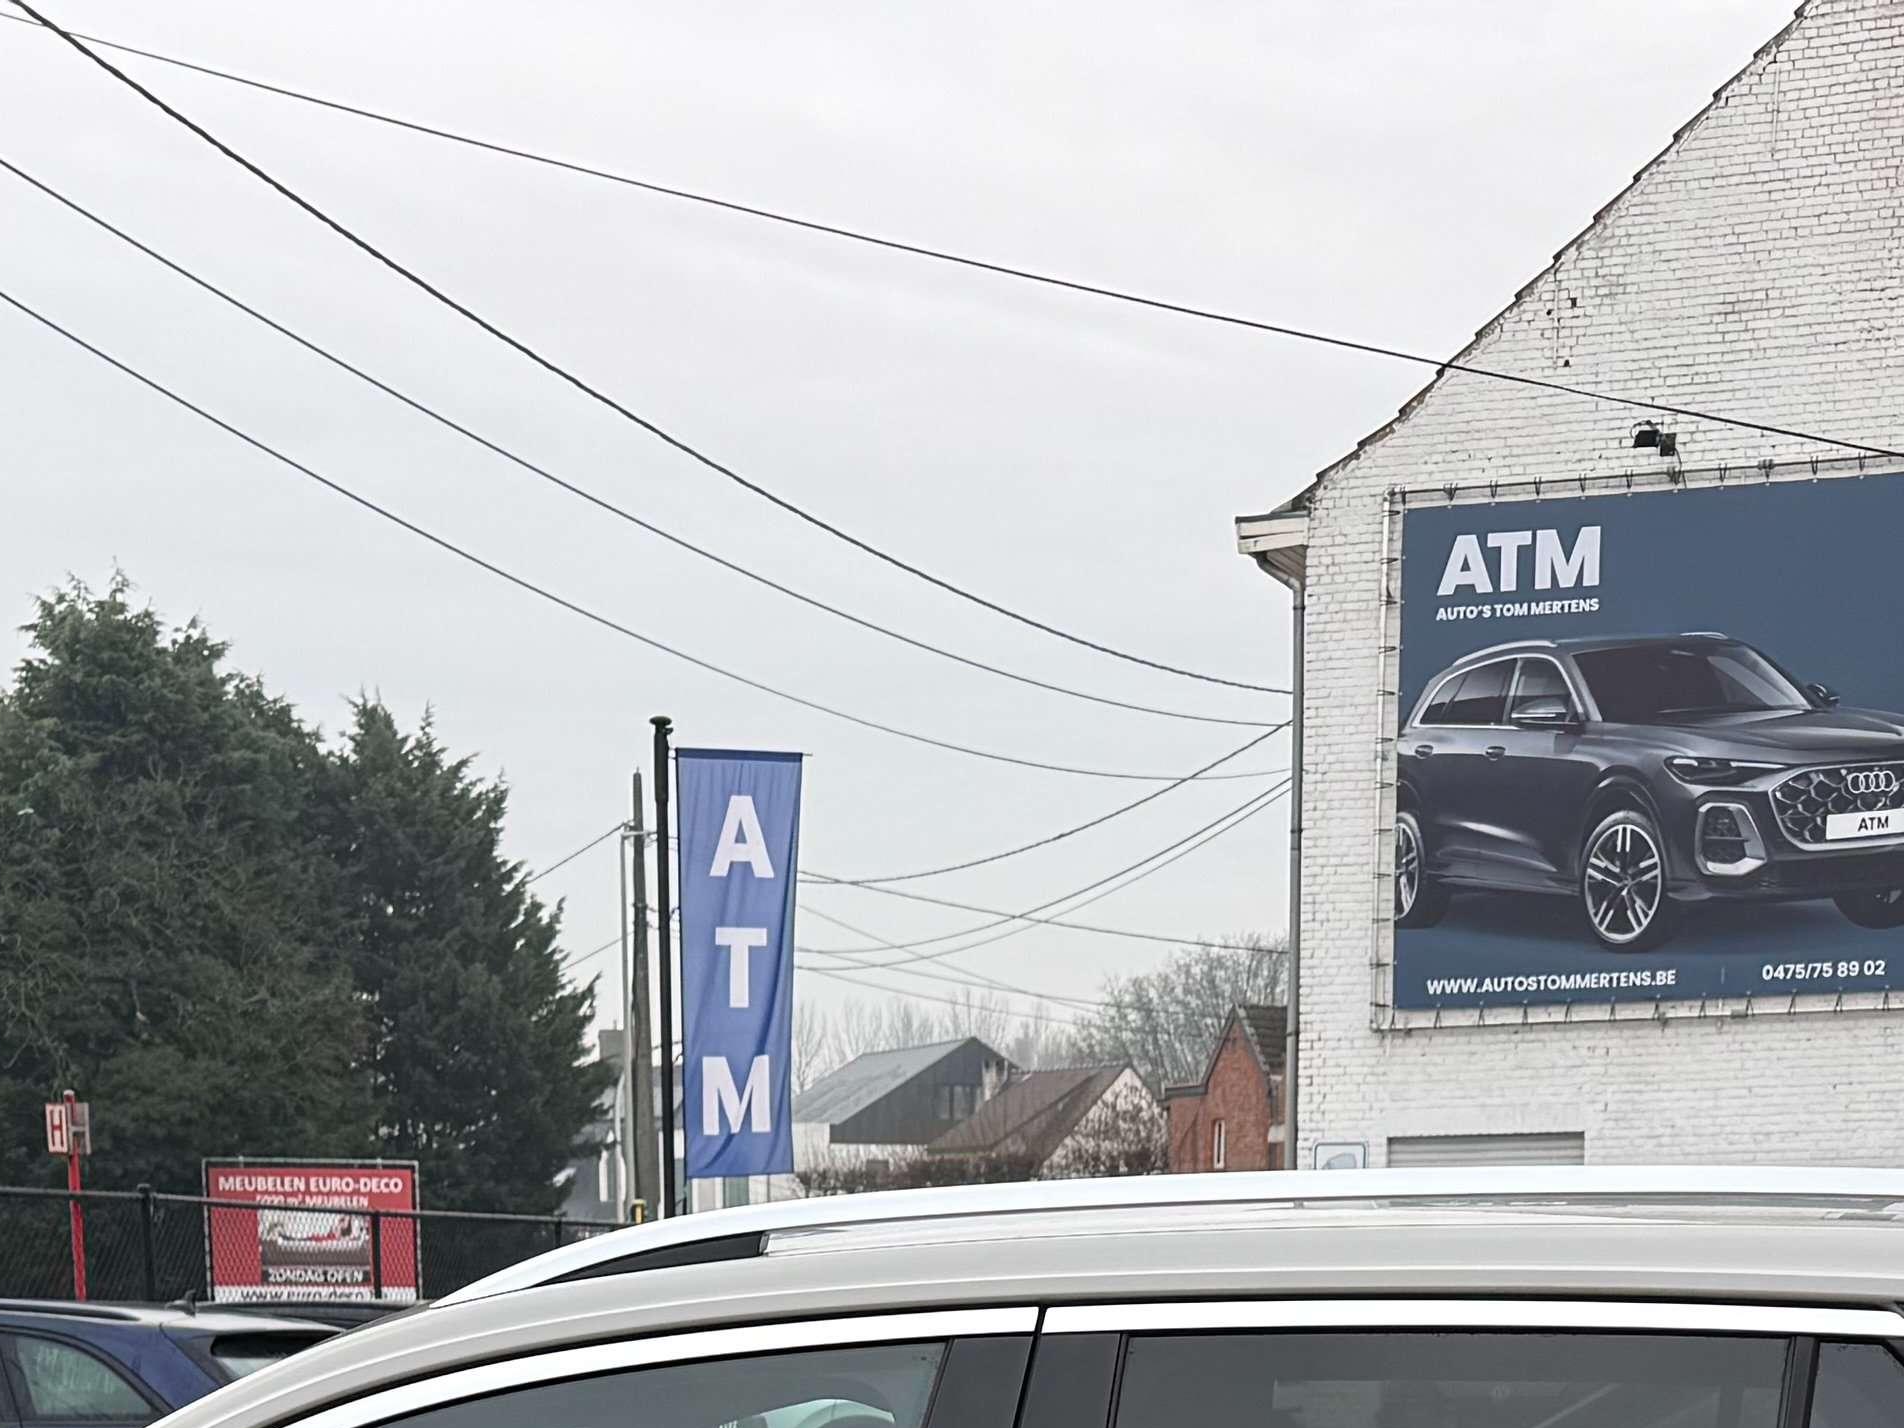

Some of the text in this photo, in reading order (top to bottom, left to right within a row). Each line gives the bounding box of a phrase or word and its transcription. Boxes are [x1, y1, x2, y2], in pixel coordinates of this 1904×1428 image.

[1436, 526, 1601, 596] ATM
[1435, 598, 1600, 621] AUTO'S TOM MERTENS
[1857, 815, 1889, 832] ATM
[1761, 959, 1886, 981] 0475/75 89 02
[1427, 969, 1677, 995] WWW.AUTOSTOMMERTENS.BE
[218, 1175, 403, 1193] MEUBELEN EURO-DECO
